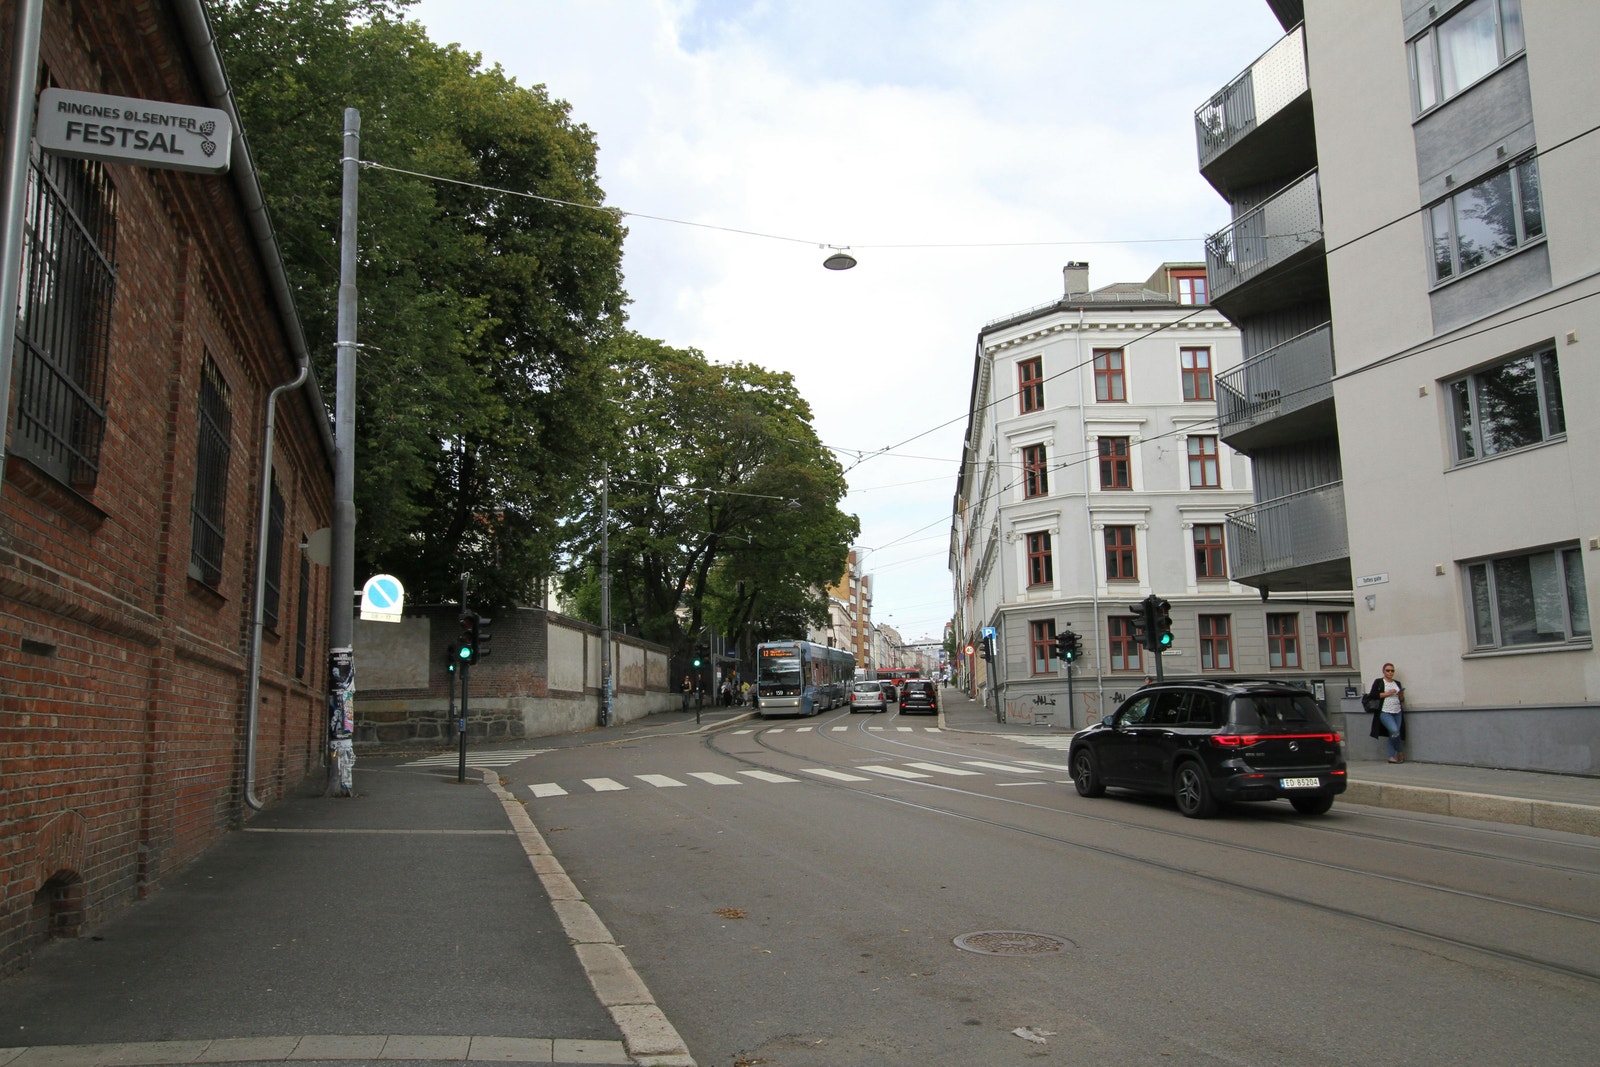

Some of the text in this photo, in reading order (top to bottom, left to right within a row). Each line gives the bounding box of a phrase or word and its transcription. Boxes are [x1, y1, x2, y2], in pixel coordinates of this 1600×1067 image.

[57, 101, 197, 130] RINGNES ØLSENTER
[65, 120, 185, 155] FESTSAL
[1285, 778, 1318, 787] ED 85204
